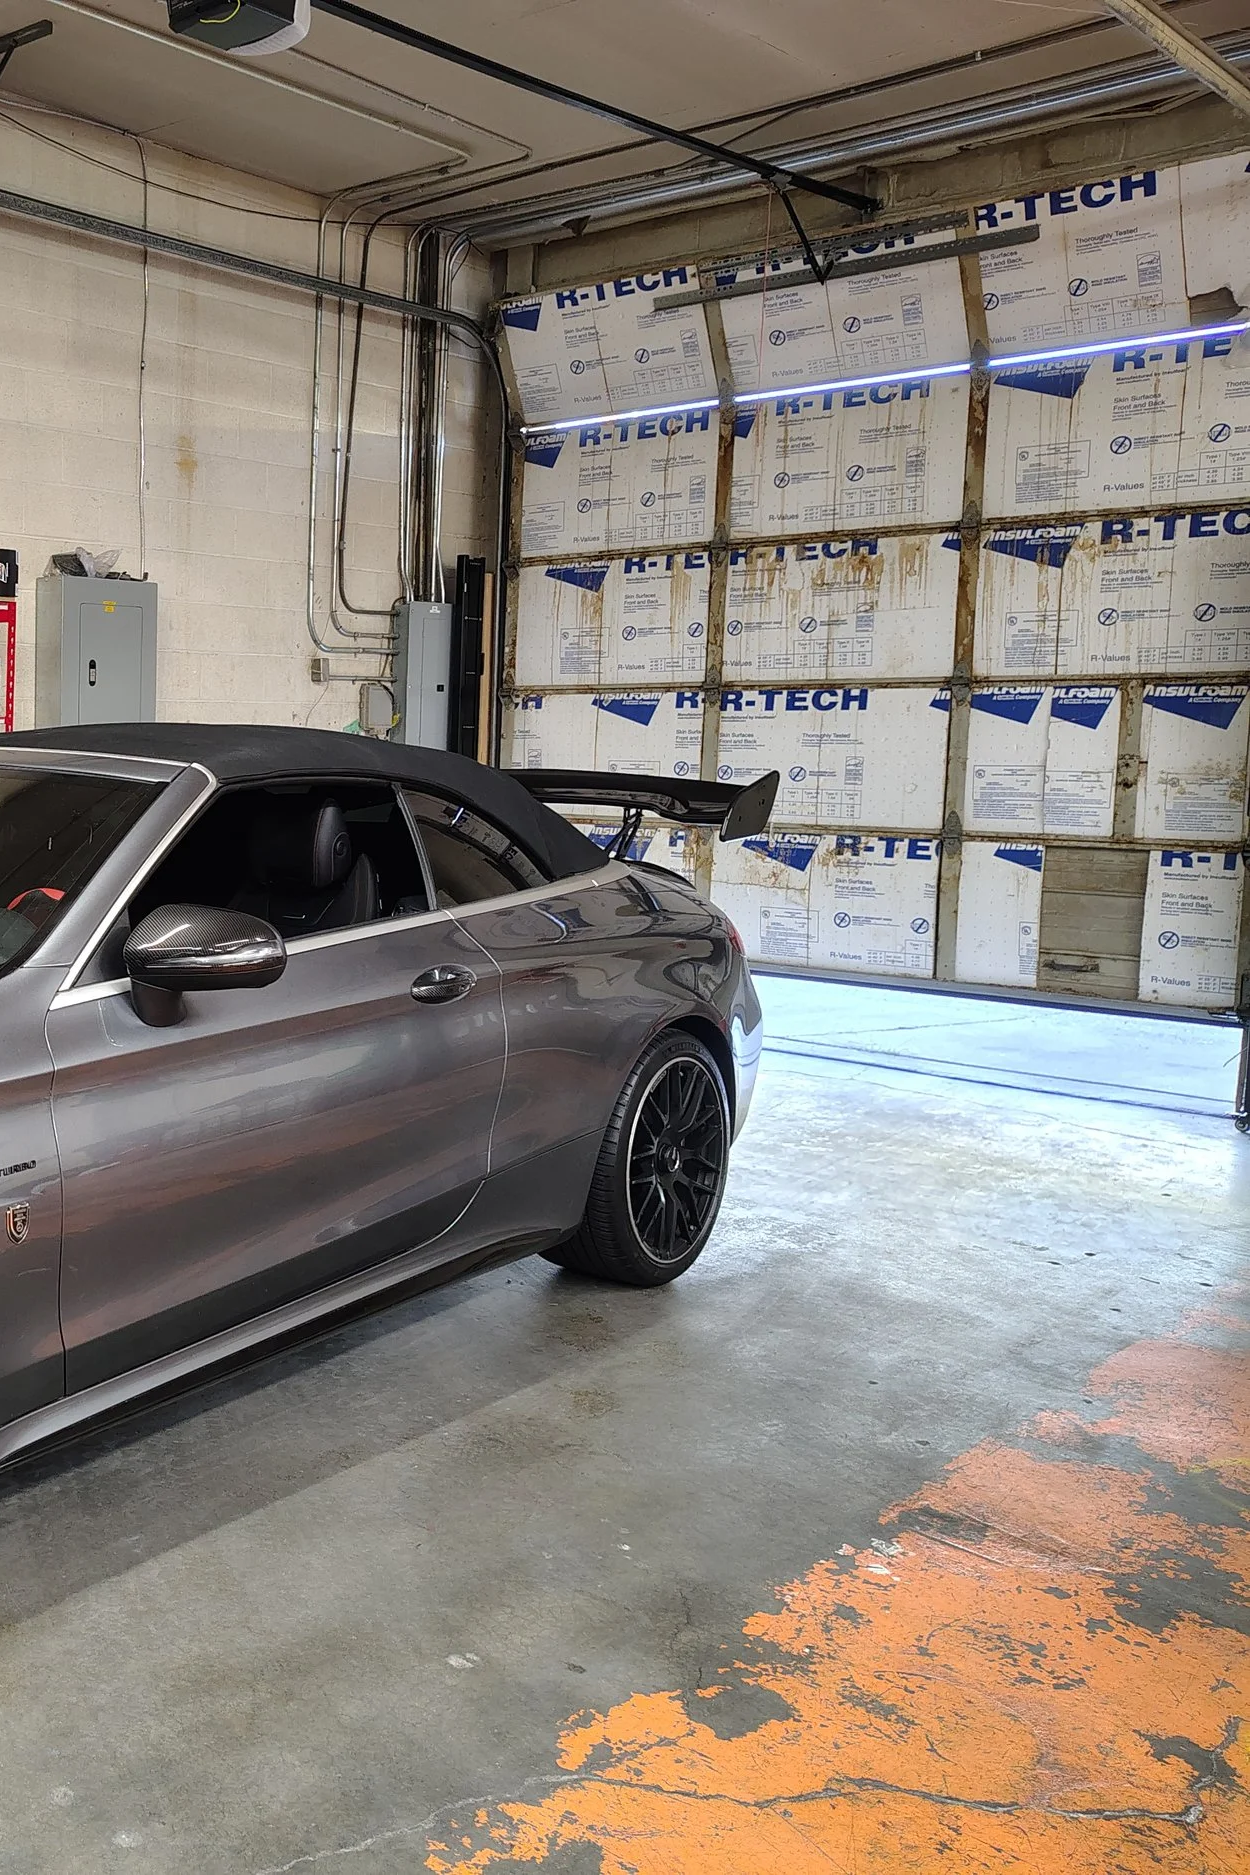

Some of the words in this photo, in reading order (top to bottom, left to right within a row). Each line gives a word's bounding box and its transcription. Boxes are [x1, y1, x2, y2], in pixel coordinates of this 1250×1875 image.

[975, 170, 1157, 231] R-TECH
[1075, 232, 1112, 245] Thoroughly
[1115, 227, 1139, 238] Tested
[990, 250, 1018, 259] Surfaces
[1006, 257, 1023, 266] Back
[557, 267, 688, 309] R-TECH
[1131, 393, 1161, 401] Surfaces
[1148, 399, 1165, 407] Back
[578, 409, 710, 448] R-TECH
[1103, 482, 1144, 492] R-Values
[768, 513, 799, 521] R-Values
[1101, 510, 1250, 545] R-TEC
[1090, 654, 1131, 662] R-Values
[720, 688, 869, 712] R-TECH
[1178, 893, 1209, 901] Surfaces
[830, 951, 862, 961] R-Values
[1151, 976, 1191, 987] R-Values
